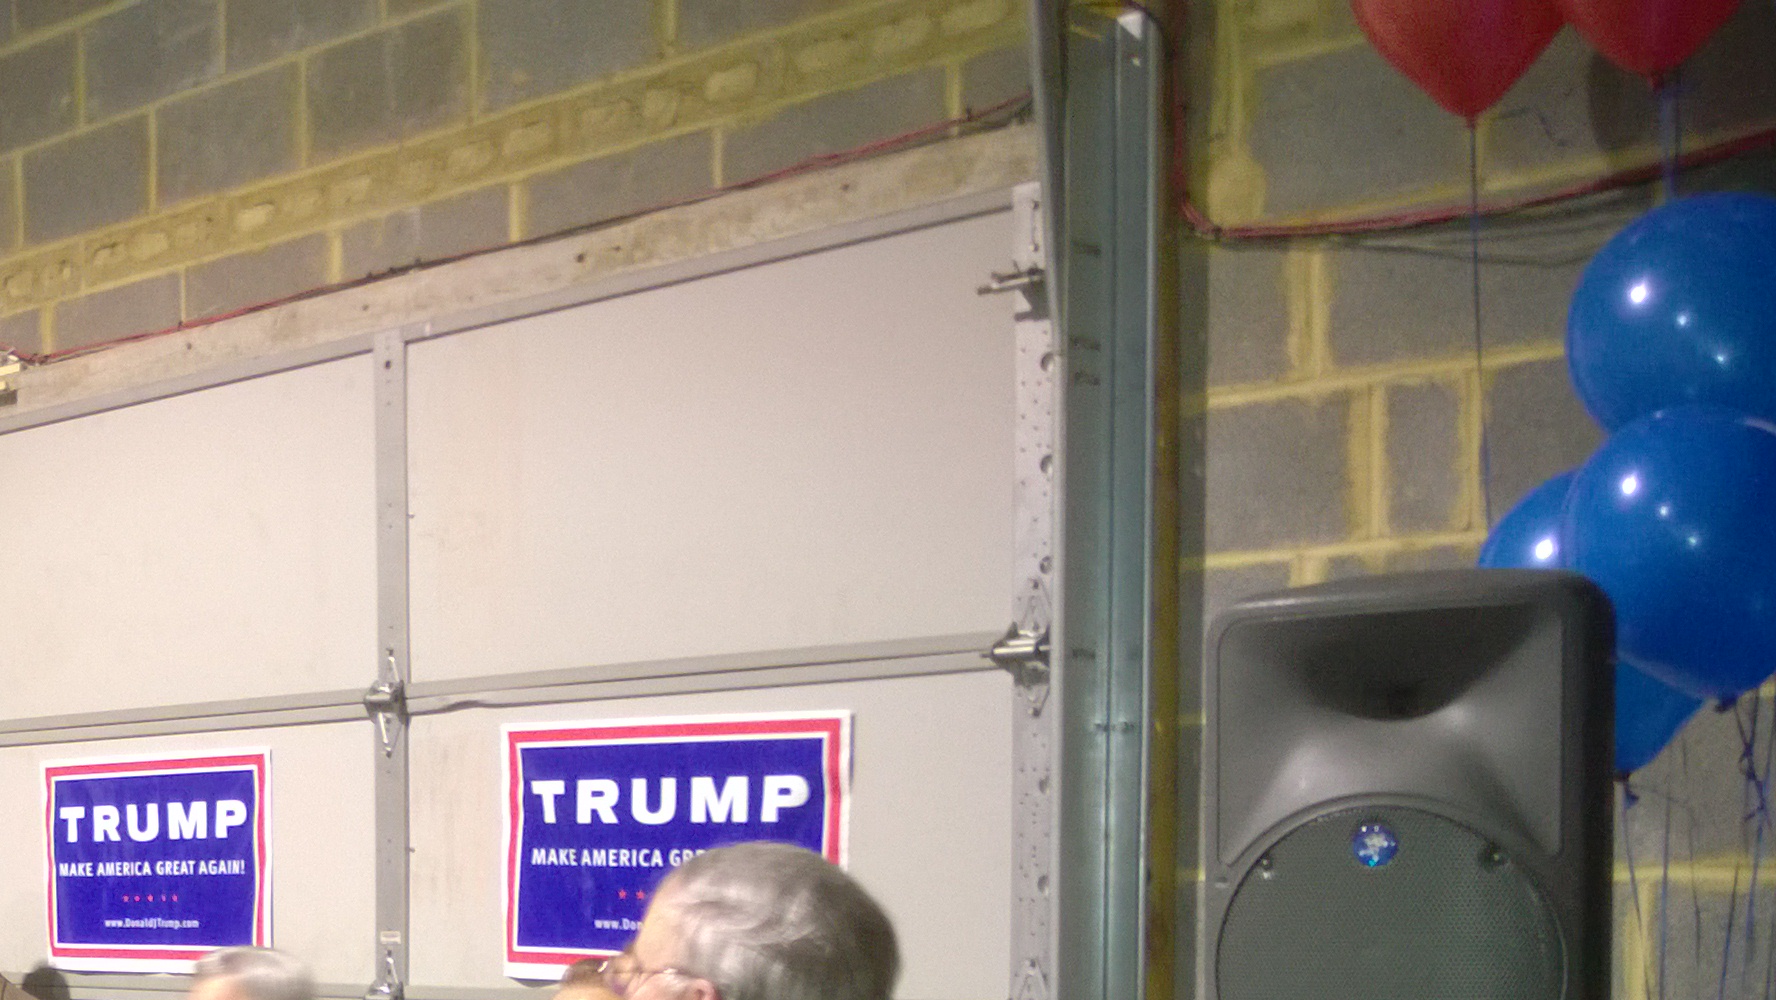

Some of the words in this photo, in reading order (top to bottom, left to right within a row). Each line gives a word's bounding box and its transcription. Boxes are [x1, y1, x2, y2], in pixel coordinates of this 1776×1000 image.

[531, 775, 809, 824] TRUMP
[59, 800, 247, 842] TRUMP
[59, 862, 94, 877] MAKE
[96, 861, 153, 877] AMERICA
[156, 860, 196, 876] GREAT
[198, 859, 246, 875] AGAIN!
[531, 848, 578, 867] MAKE
[581, 849, 664, 868] AMERICA
